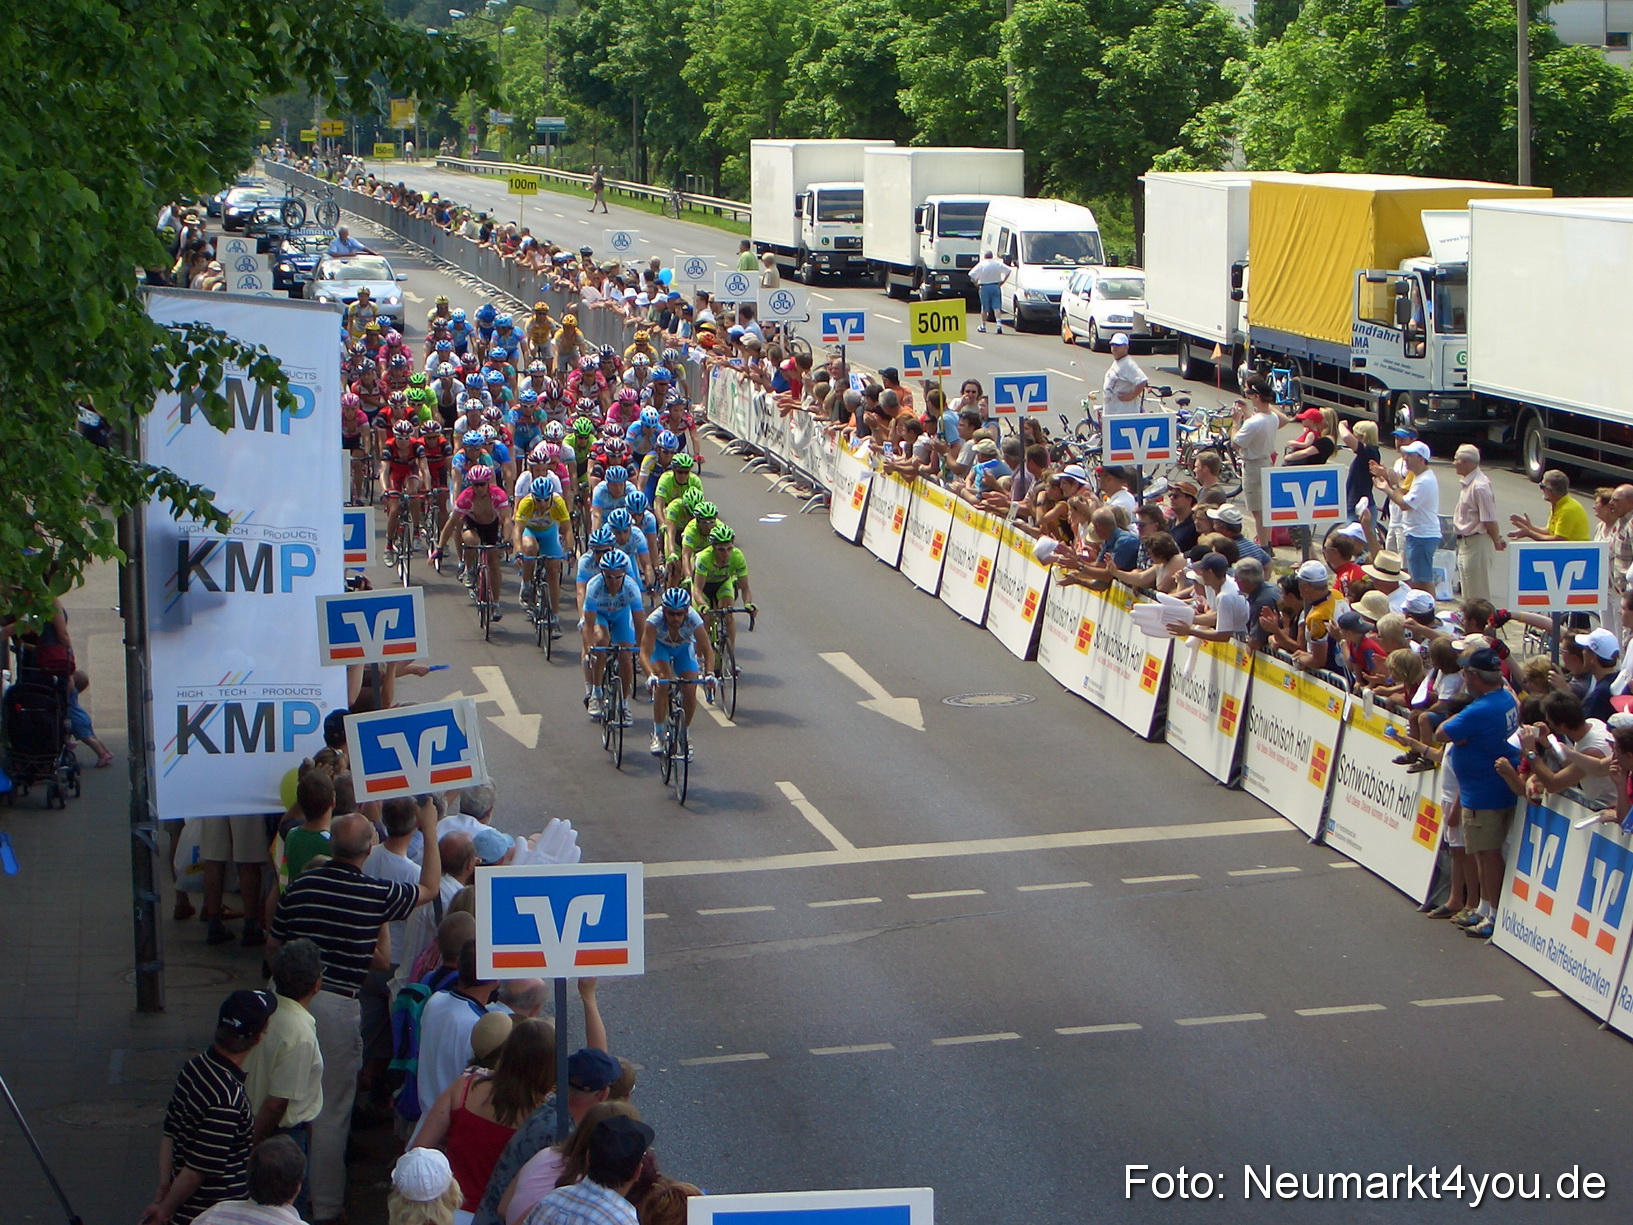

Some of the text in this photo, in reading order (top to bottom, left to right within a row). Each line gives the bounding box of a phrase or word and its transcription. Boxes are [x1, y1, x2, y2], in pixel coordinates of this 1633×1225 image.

[509, 178, 537, 190] 100m
[918, 311, 959, 334] 50m
[1353, 323, 1401, 344] undfahrt
[180, 376, 316, 436] KMP
[178, 525, 204, 534] HIGH
[263, 529, 318, 541] PRODUCTS
[177, 540, 317, 594] KMP
[177, 690, 203, 698] HIGH
[219, 688, 247, 697] TECH
[262, 688, 322, 696] PRODUCTS
[177, 701, 320, 755] KMP
[1249, 704, 1295, 755] Schwäbisch
[1294, 729, 1312, 764] Hall
[1338, 753, 1418, 822] Schwäbisch Hall
[1501, 907, 1611, 998] Volksbanken Raiffeisenbanken
